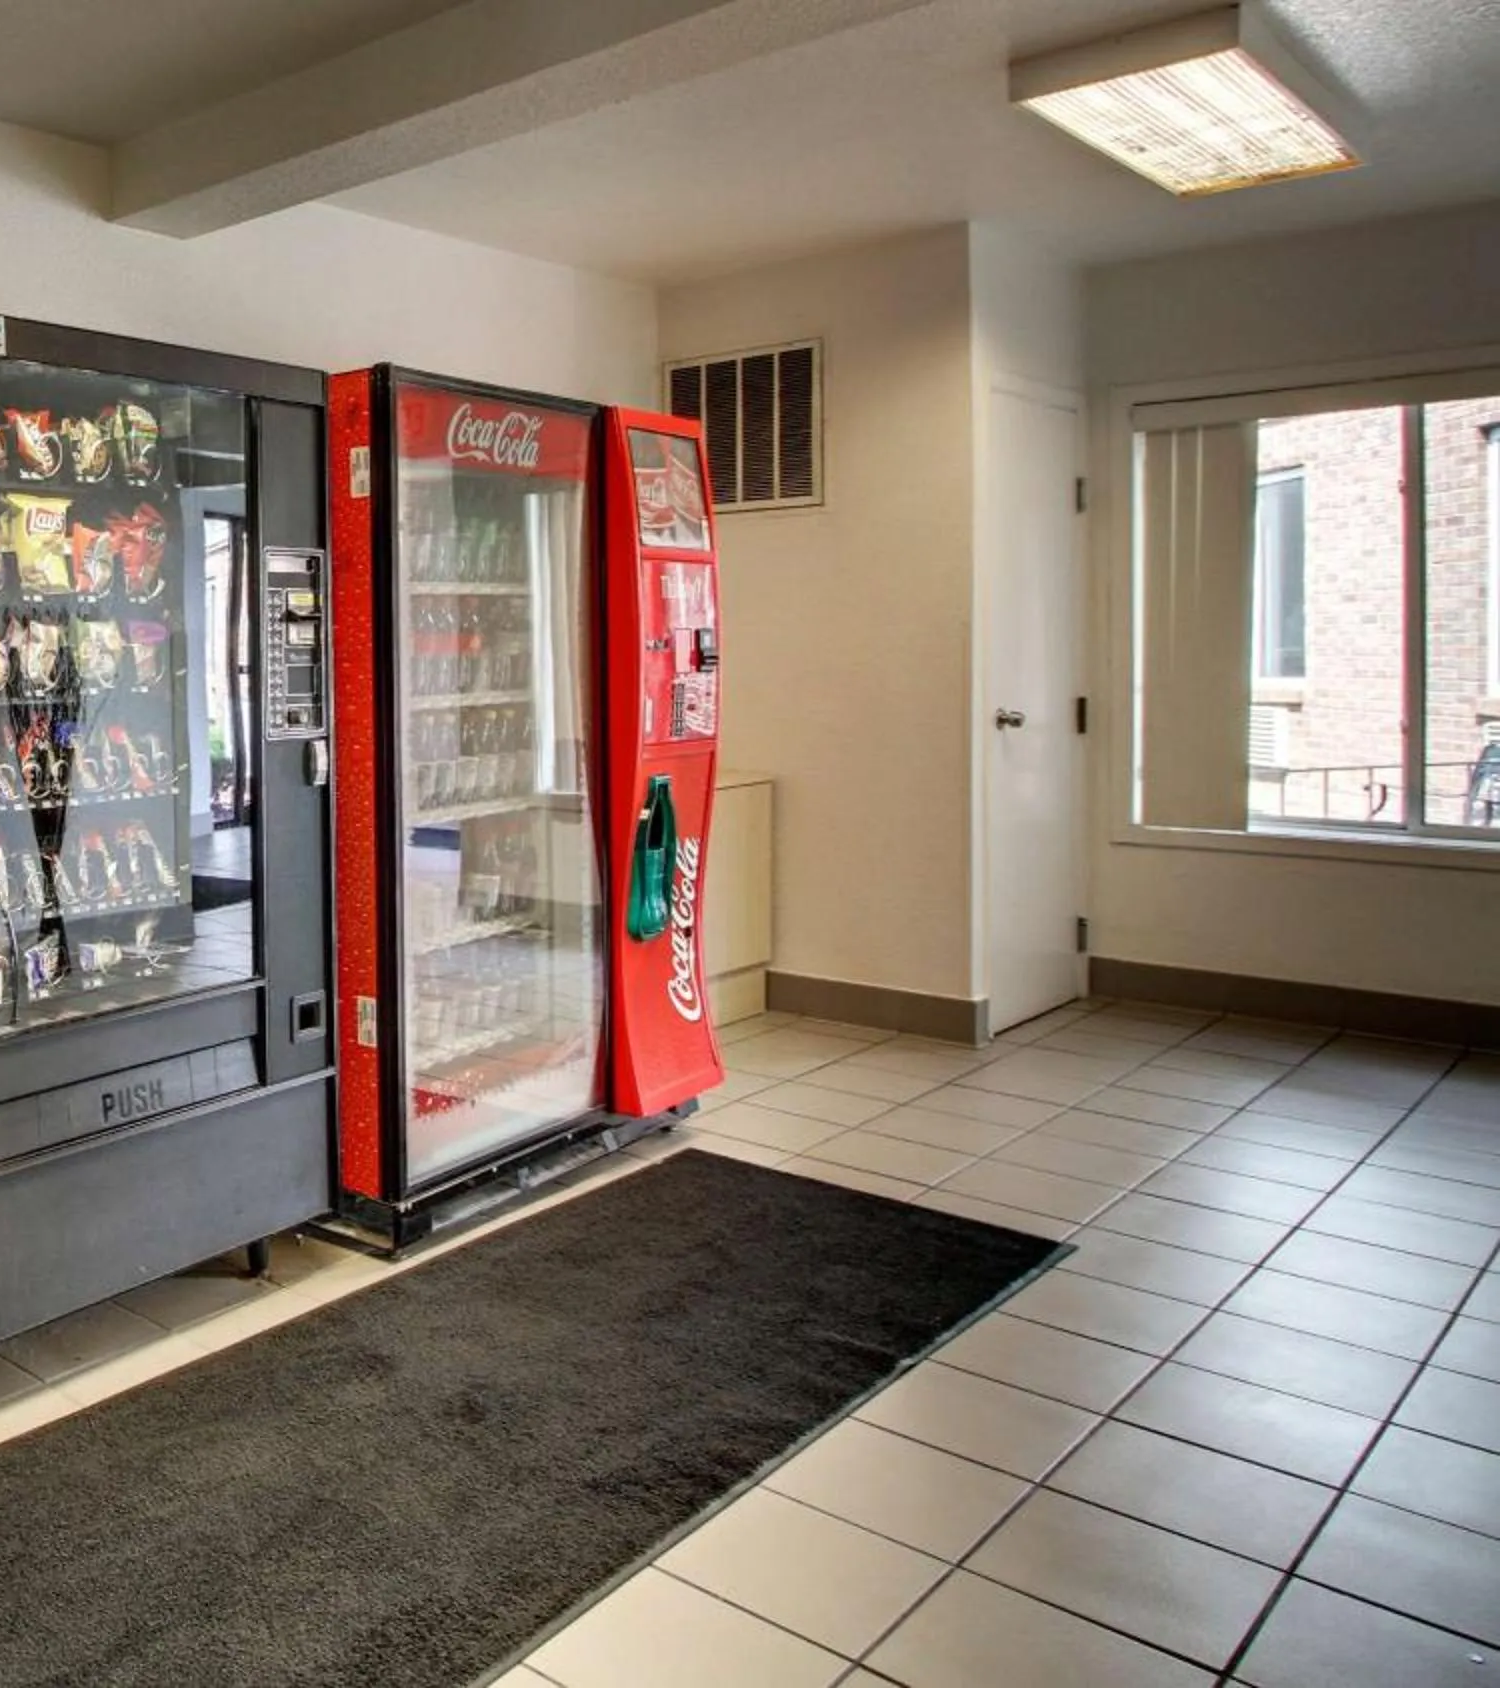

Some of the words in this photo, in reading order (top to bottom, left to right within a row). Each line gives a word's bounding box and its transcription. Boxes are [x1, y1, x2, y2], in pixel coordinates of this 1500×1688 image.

[447, 402, 544, 467] Coca-Cola
[666, 833, 701, 1023] Coca-Cola
[101, 1079, 165, 1124] PUSH
